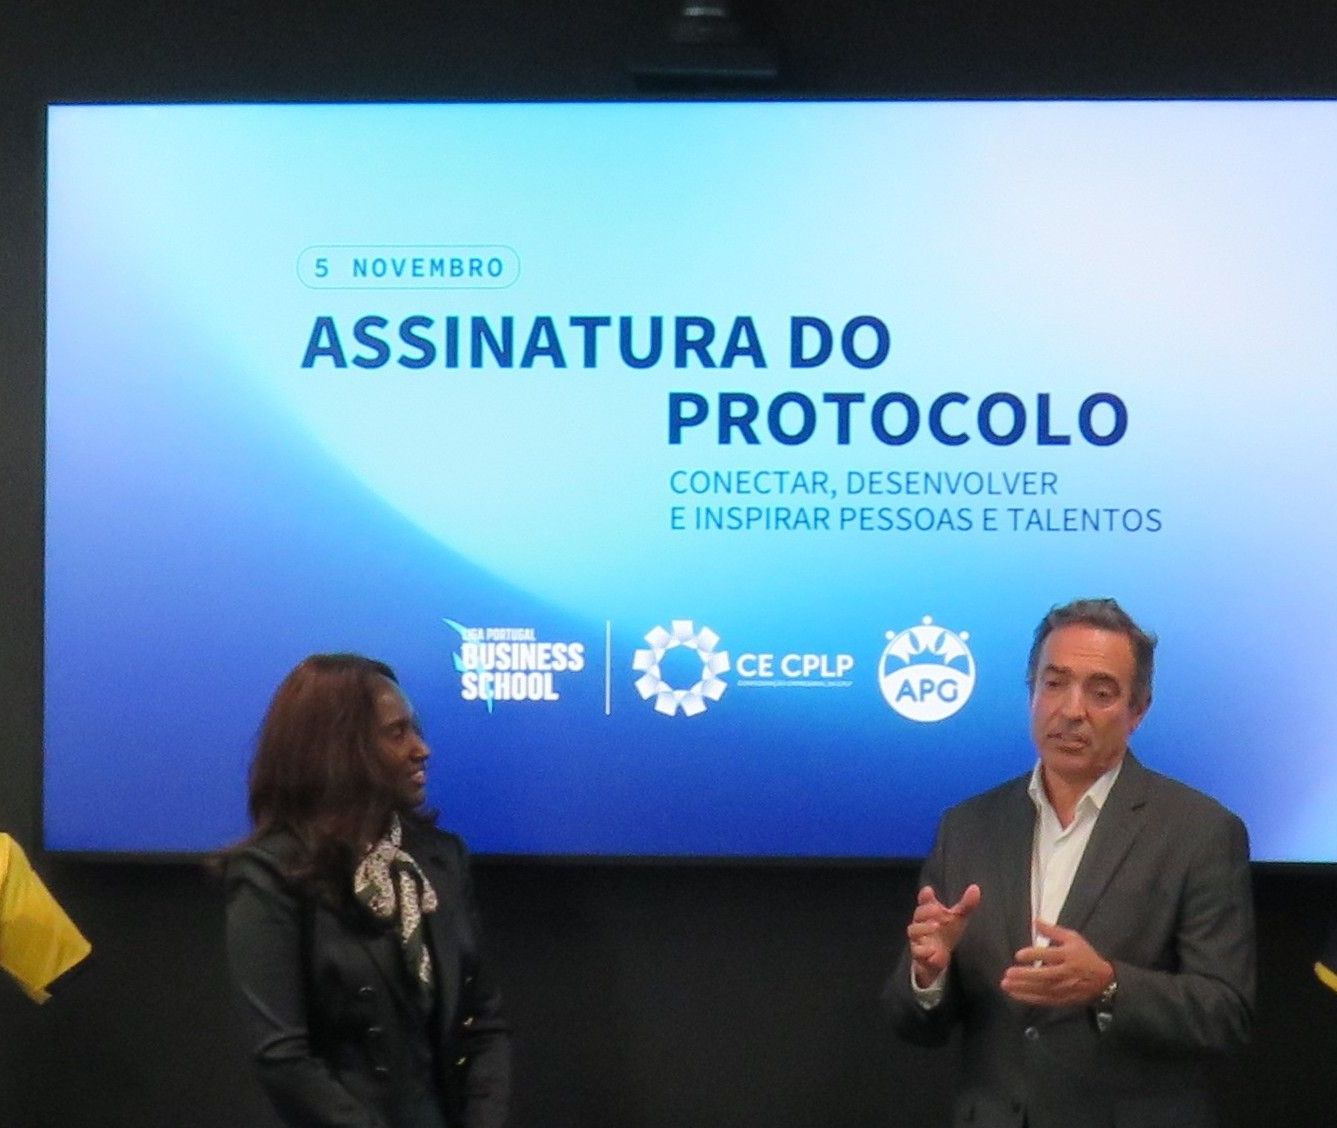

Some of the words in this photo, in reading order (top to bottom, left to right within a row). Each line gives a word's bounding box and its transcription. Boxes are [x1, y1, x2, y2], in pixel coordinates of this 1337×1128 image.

[315, 258, 329, 278] 5
[352, 257, 504, 278] NOVEMBRO
[301, 315, 768, 370] ASSINATURA
[790, 315, 892, 370] DO
[667, 391, 1129, 447] PROTOCOLO
[670, 470, 837, 499] CONECTAR,
[847, 471, 1058, 496] DESENVOLVER
[671, 506, 686, 531] E
[695, 506, 830, 531] INSPIRAR
[840, 507, 973, 532] PESSOAS
[983, 508, 998, 532] E
[1007, 508, 1163, 533] TALENTOS
[461, 641, 585, 672] BUSINESS
[736, 653, 774, 678] CE
[780, 653, 854, 678] CPLP
[461, 671, 560, 701] SCHOOL
[895, 678, 959, 703] APG
